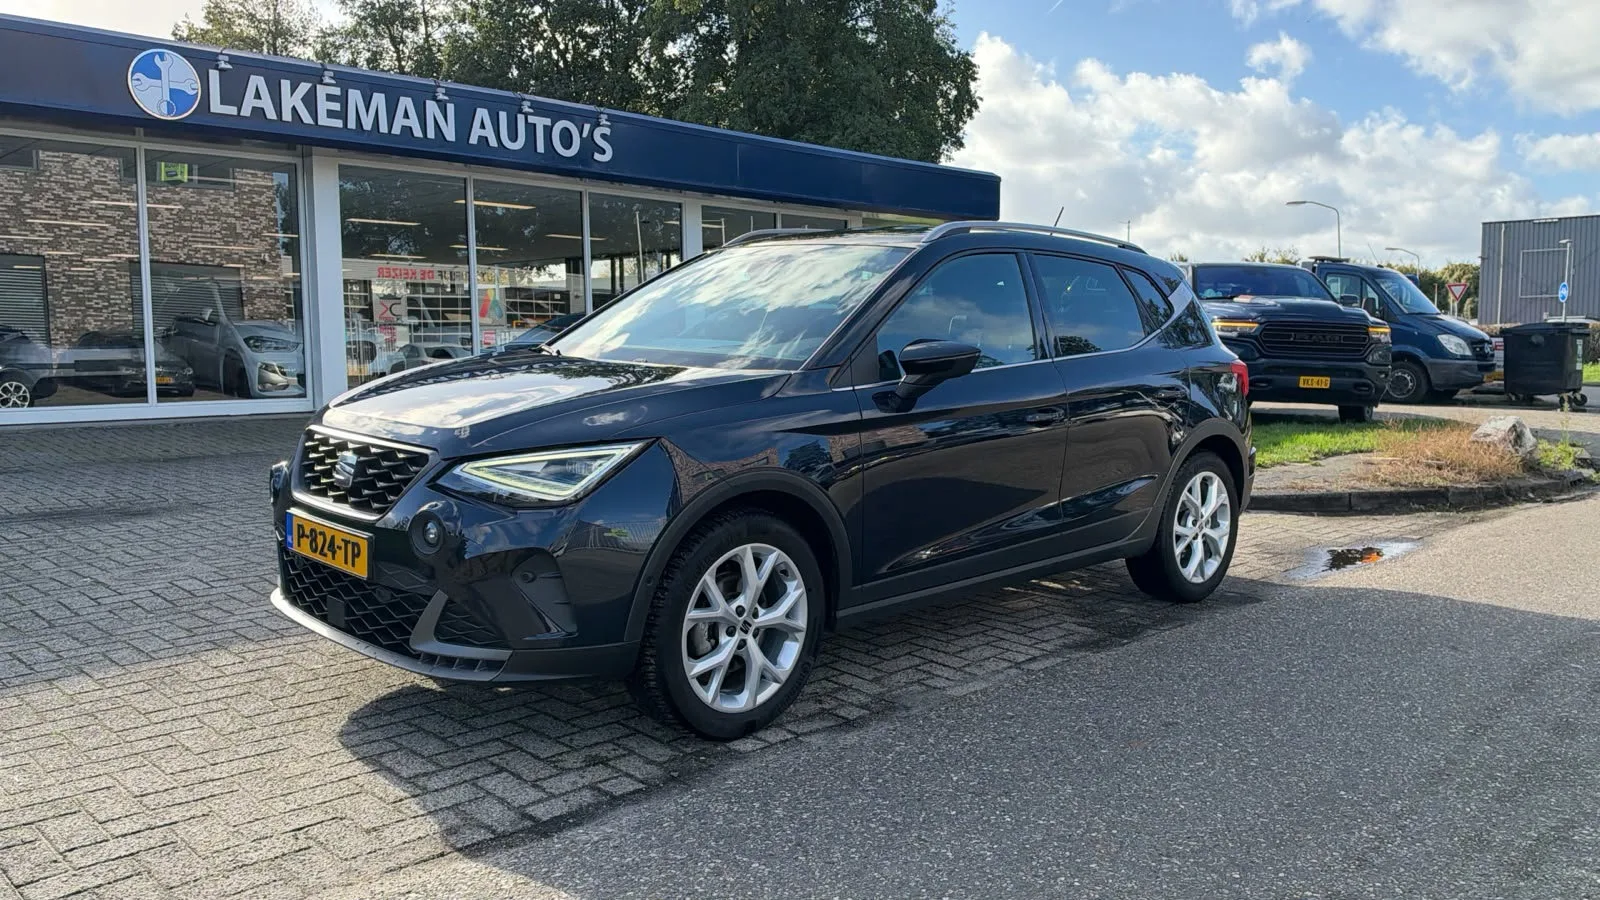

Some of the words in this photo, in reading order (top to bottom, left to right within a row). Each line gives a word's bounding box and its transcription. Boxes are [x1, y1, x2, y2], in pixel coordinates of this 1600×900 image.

[208, 69, 456, 142] LAKEMAN
[468, 107, 614, 163] AUTO'S
[296, 522, 362, 568] P-824-TP
